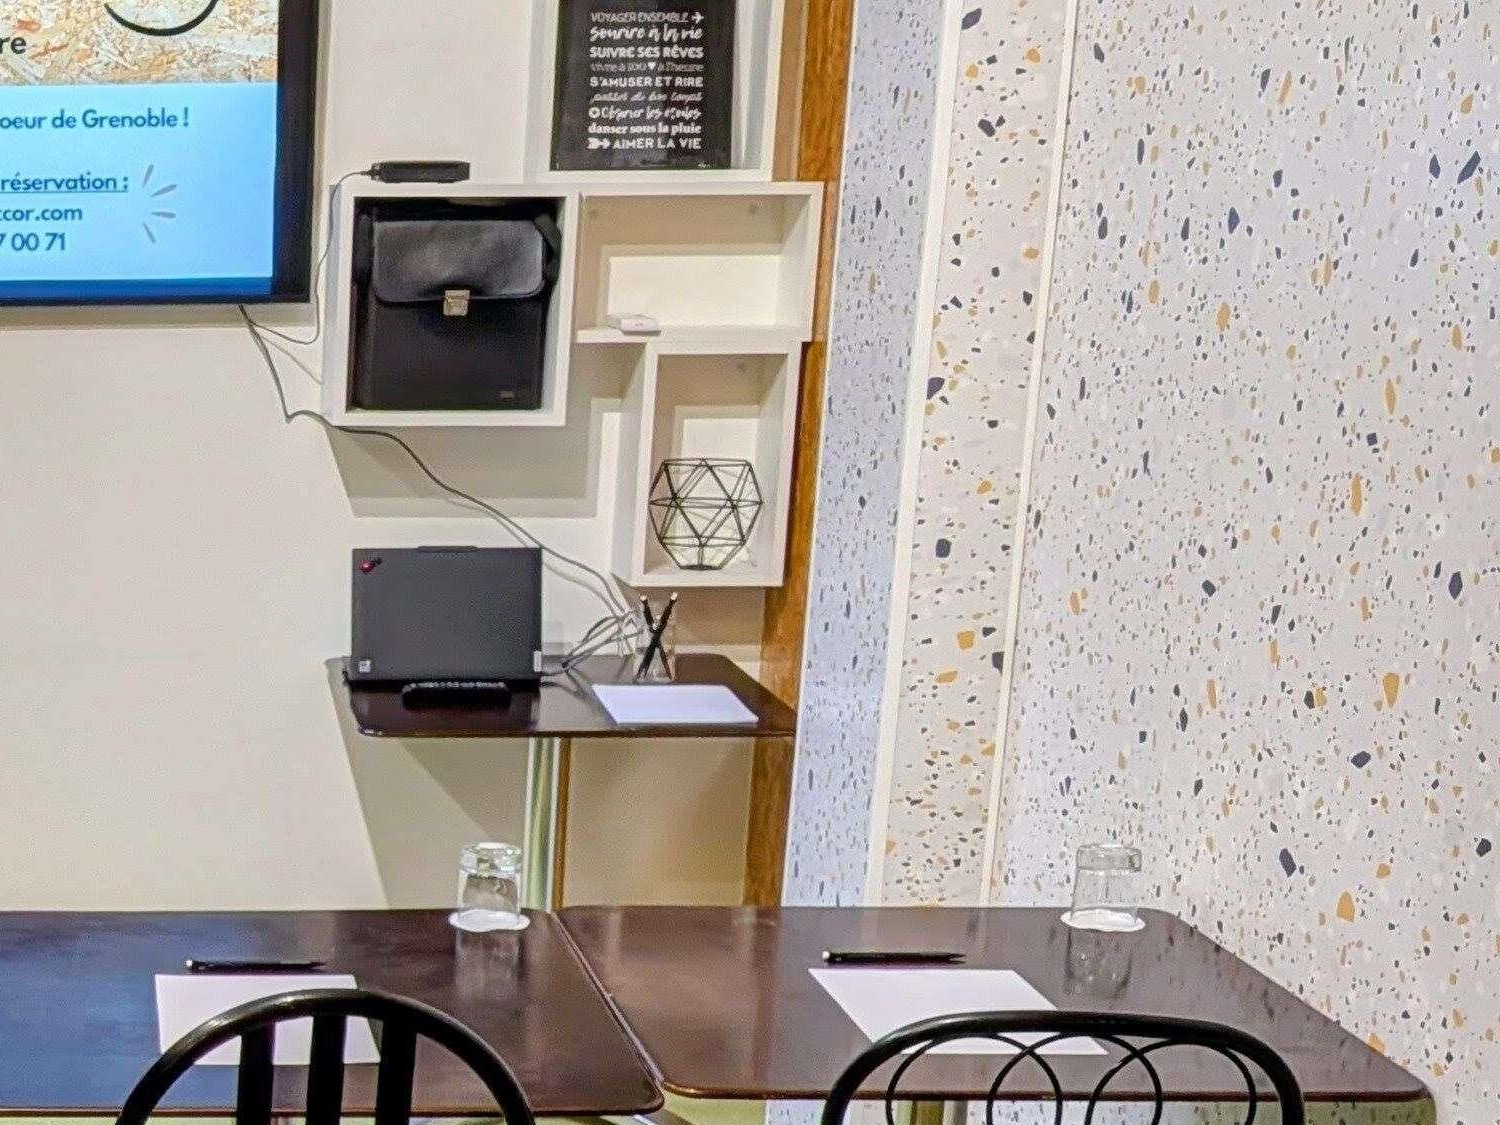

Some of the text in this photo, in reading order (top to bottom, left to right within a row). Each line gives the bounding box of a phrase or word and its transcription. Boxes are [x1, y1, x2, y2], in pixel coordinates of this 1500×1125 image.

[590, 76, 704, 87] S'AMUSER ET RIRE
[51, 109, 77, 129] de
[82, 107, 178, 129] Grenoble
[183, 107, 190, 127] !
[613, 138, 702, 149] AIMER LA VIE
[0, 172, 118, 192] réservation
[11, 232, 40, 252] 00
[45, 232, 66, 251] 71
